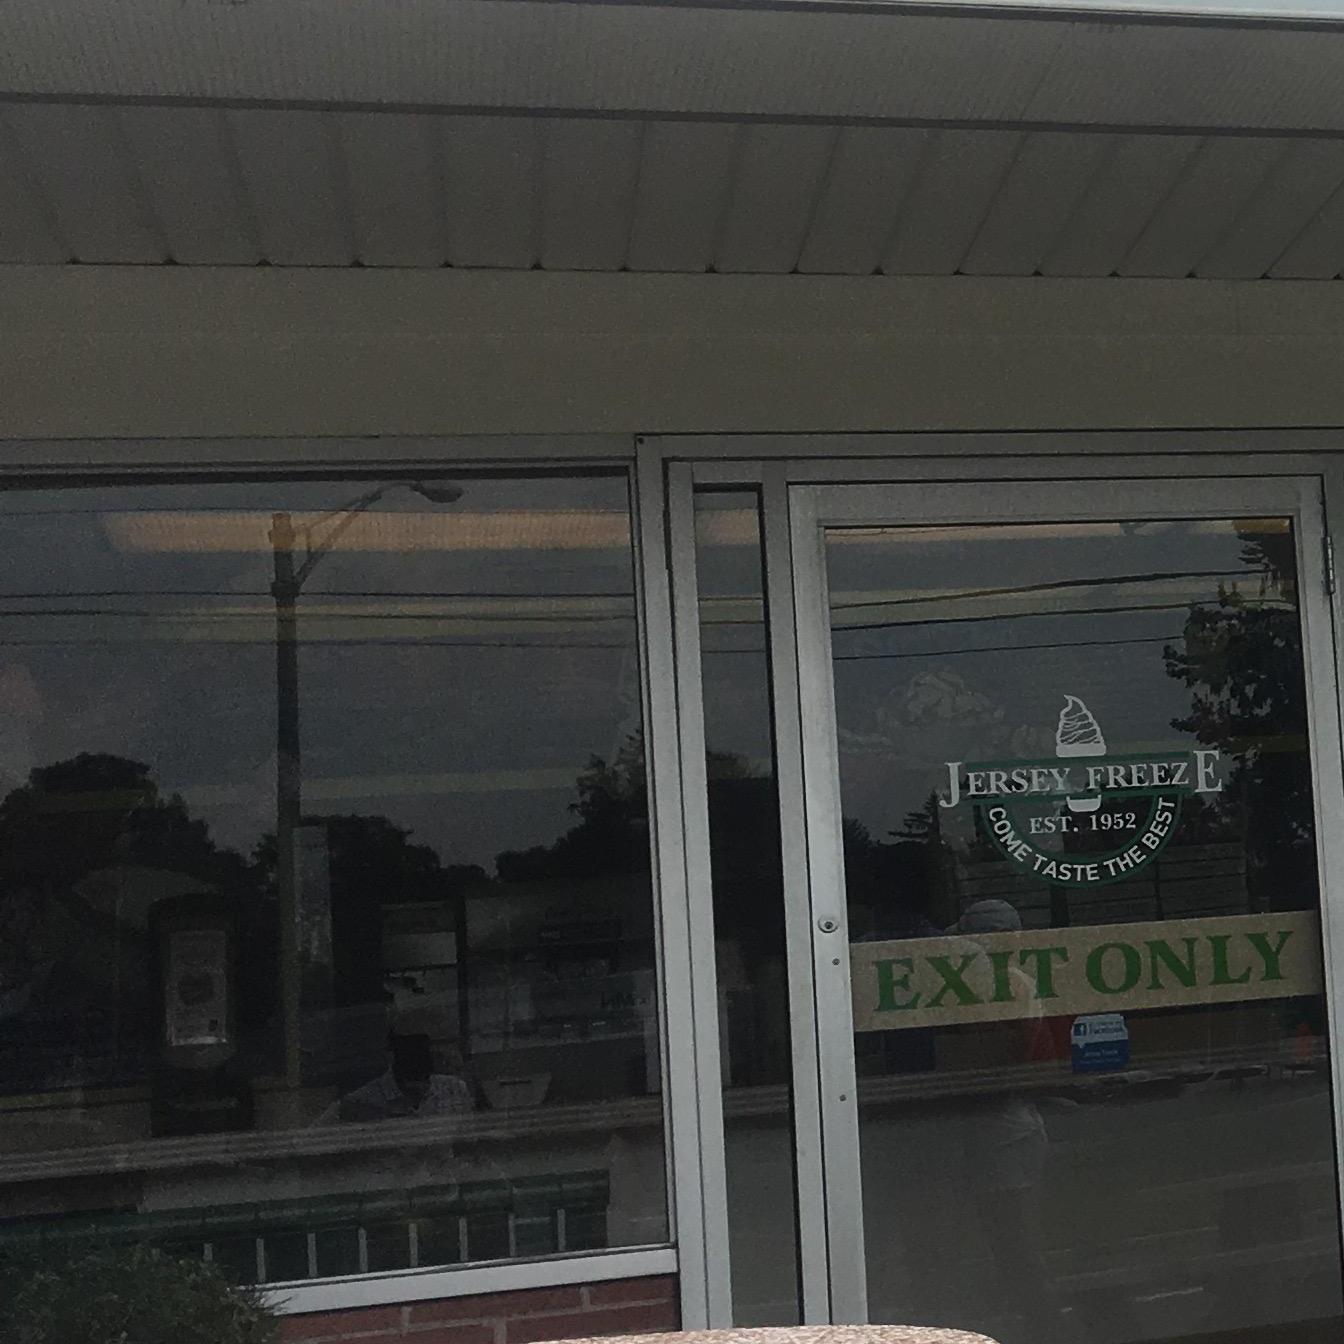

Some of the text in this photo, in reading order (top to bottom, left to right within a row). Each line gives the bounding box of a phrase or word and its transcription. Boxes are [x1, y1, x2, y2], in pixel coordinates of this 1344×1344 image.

[939, 750, 1222, 807] JERSEY FREEZE
[989, 797, 1175, 881] COME TASTE THE BEST
[1029, 812, 1136, 834] EST. 1952
[872, 931, 1294, 1012] EXIT ONLY
